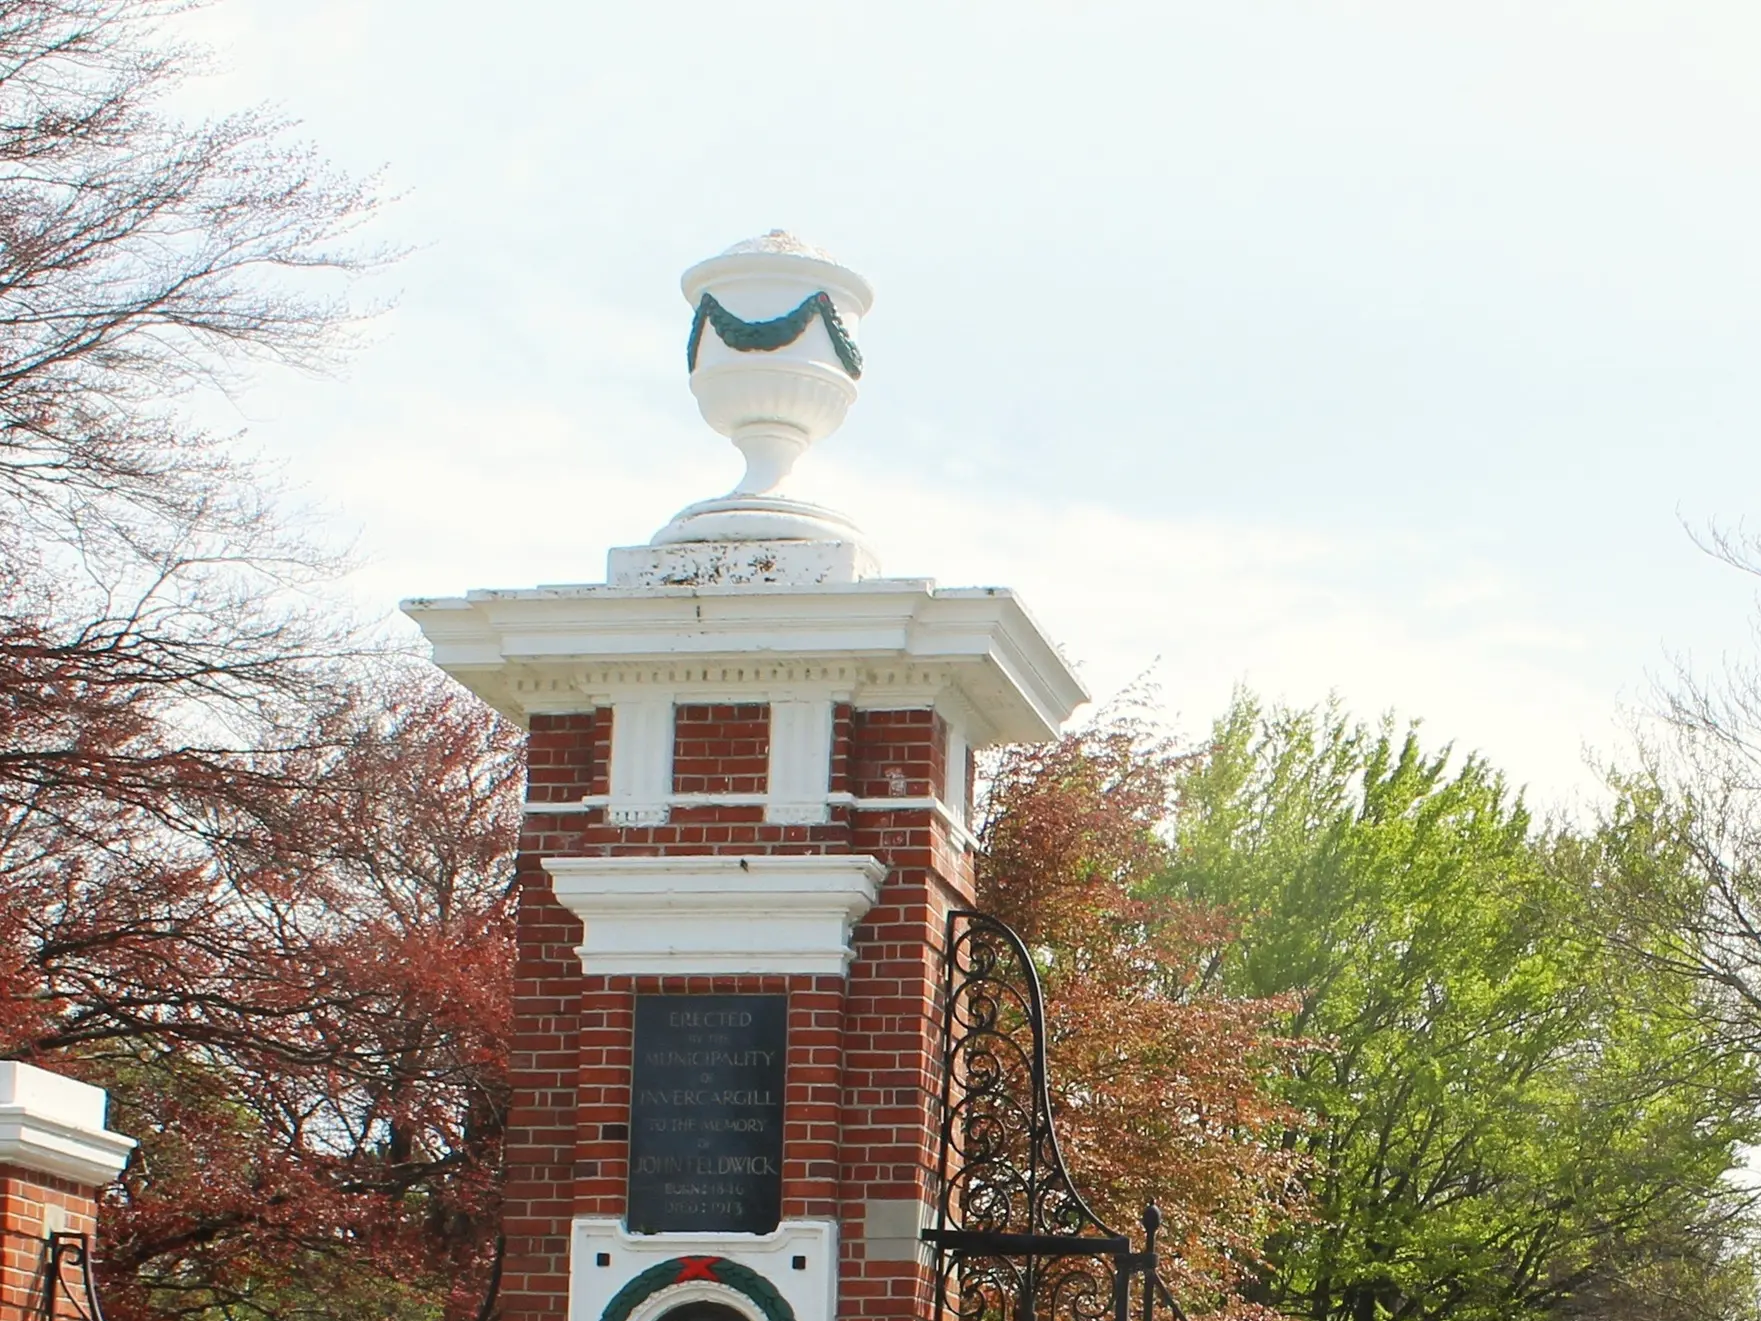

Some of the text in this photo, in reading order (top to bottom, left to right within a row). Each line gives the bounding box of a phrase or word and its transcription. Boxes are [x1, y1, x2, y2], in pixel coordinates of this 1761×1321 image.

[670, 1012, 752, 1027] ERECTED
[644, 1050, 775, 1066] MUNICIPALITY
[700, 1072, 714, 1084] OF
[640, 1090, 776, 1106] INVERCARGILL
[672, 1118, 696, 1131] THE
[701, 1119, 766, 1132] MEMORY
[633, 1156, 778, 1175] JOHN FELDWICK
